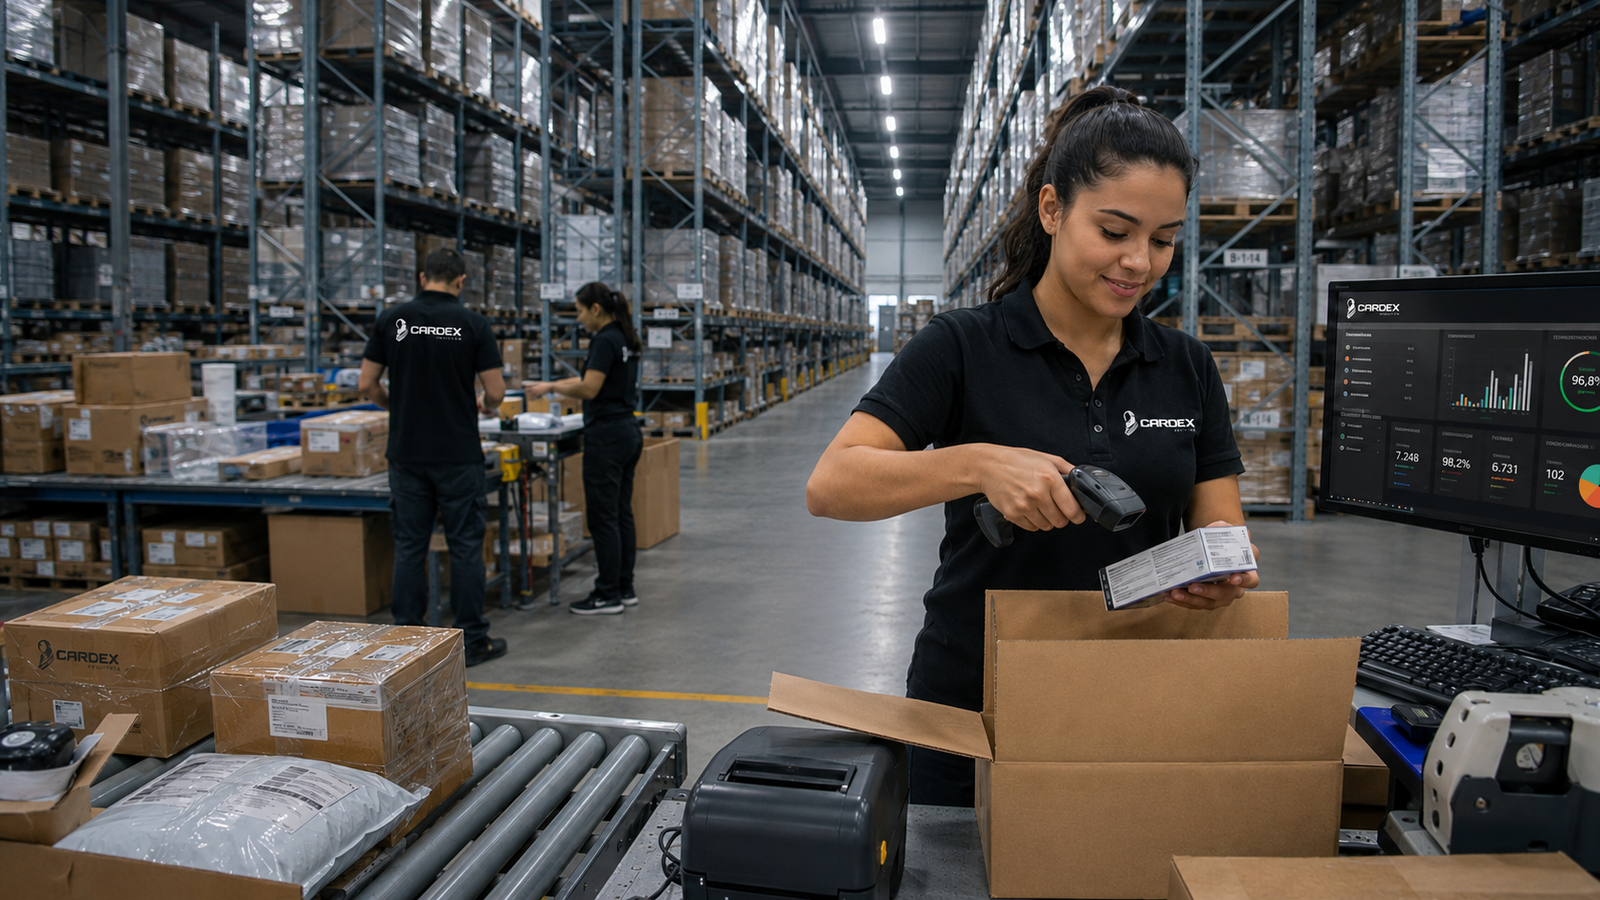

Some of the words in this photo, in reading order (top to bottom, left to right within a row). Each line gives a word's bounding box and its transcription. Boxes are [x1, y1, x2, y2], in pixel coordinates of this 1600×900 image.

[1357, 303, 1400, 312] CARDEX
[410, 325, 462, 337] CARDEX
[1140, 418, 1195, 428] CARDEX
[1395, 450, 1419, 463] 7.248
[1442, 456, 1471, 470] 98,2%
[1491, 462, 1518, 475] 6.731
[1546, 469, 1565, 481] 102
[56, 649, 119, 665] CARDEX
